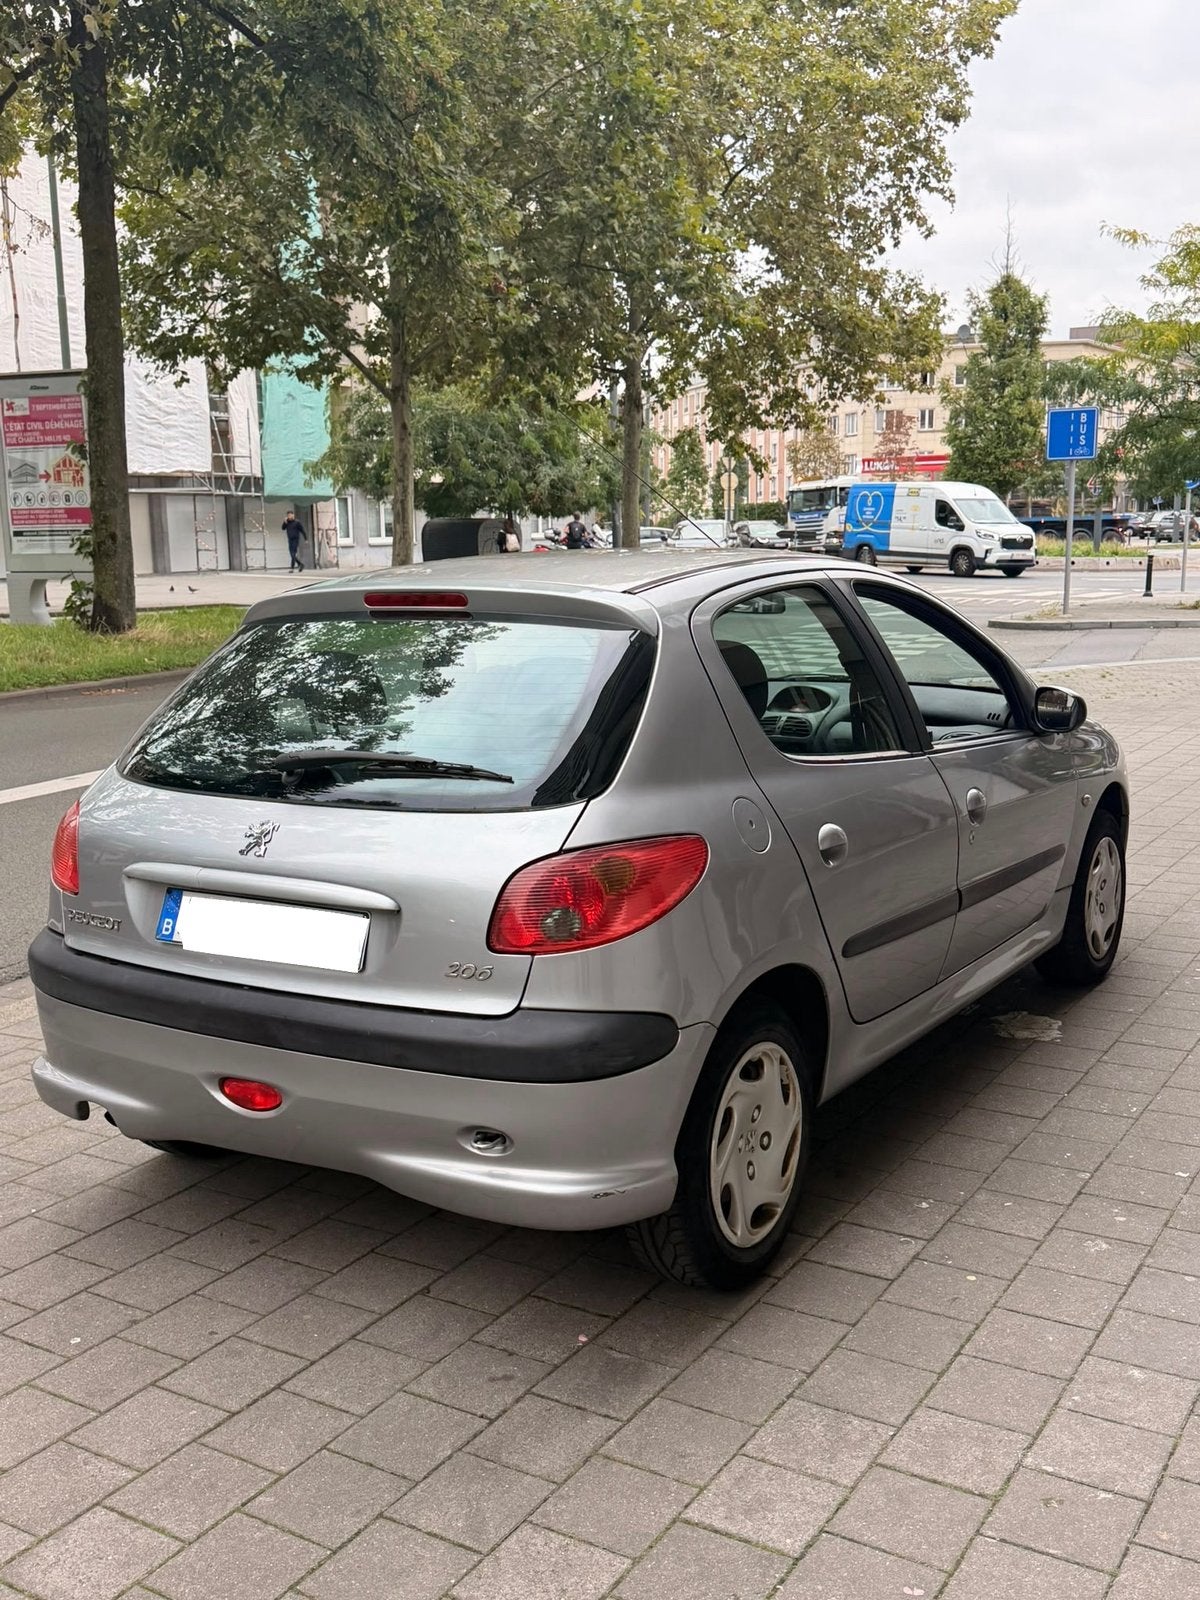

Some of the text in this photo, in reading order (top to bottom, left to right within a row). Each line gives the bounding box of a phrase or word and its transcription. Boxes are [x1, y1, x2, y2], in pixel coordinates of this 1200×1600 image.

[27, 421, 44, 430] CIVIL
[45, 419, 84, 429] DÉMÉNAGE
[68, 908, 122, 932] PEUGEOT
[162, 918, 173, 935] B
[445, 961, 494, 981] 206
